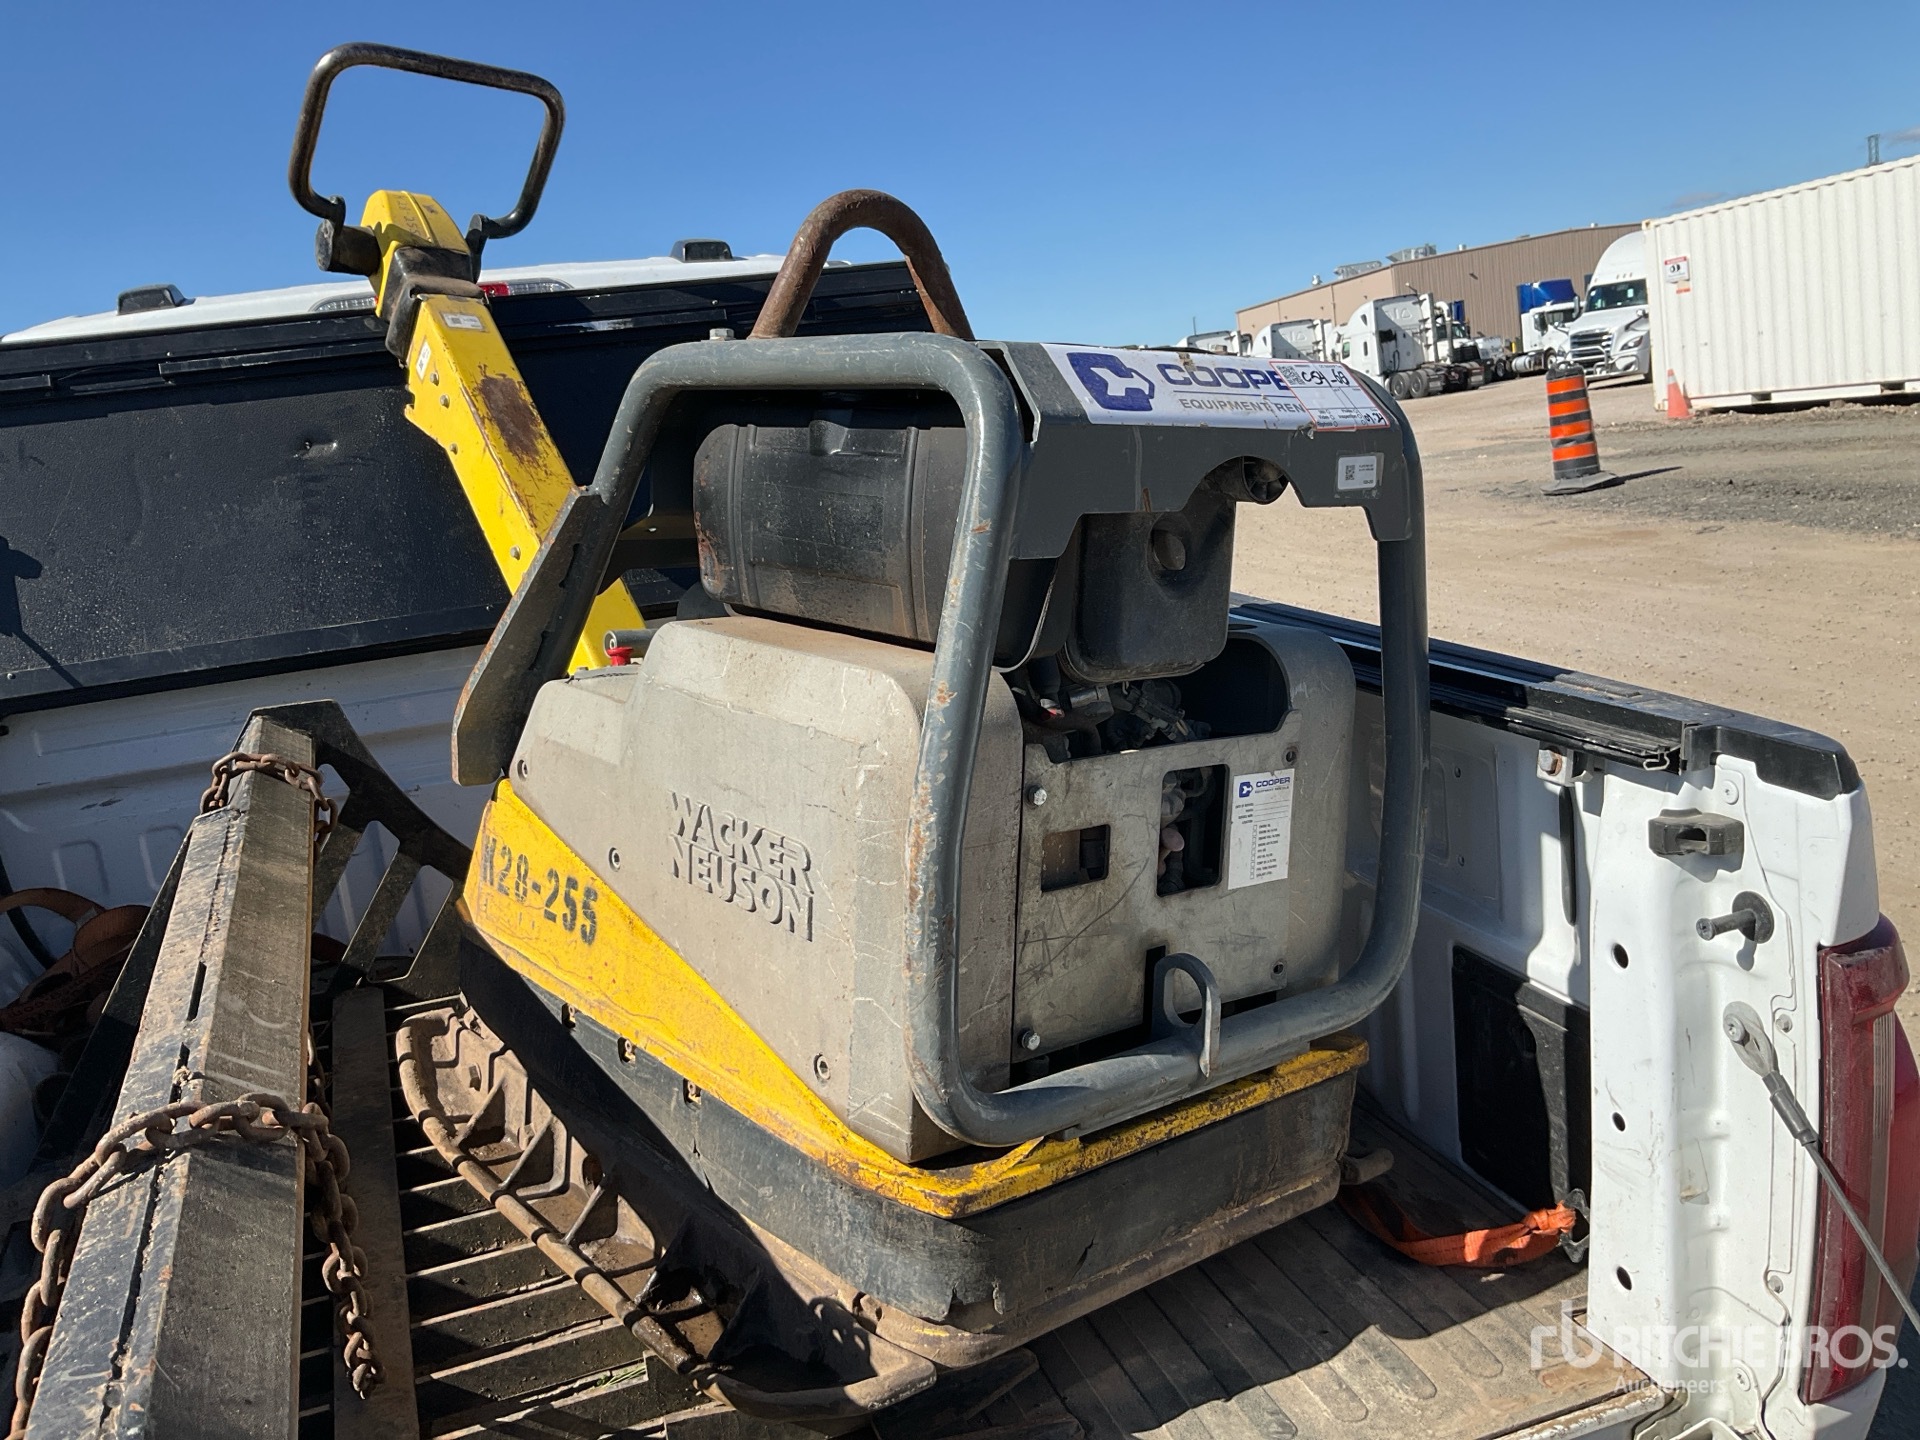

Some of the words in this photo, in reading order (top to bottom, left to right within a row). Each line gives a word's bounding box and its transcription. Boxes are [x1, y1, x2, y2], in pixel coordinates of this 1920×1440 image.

[1178, 398, 1271, 412] EQUIPMENT
[1255, 776, 1291, 788] COOPER
[667, 788, 814, 895] WACKER
[668, 833, 814, 942] NEUSON
